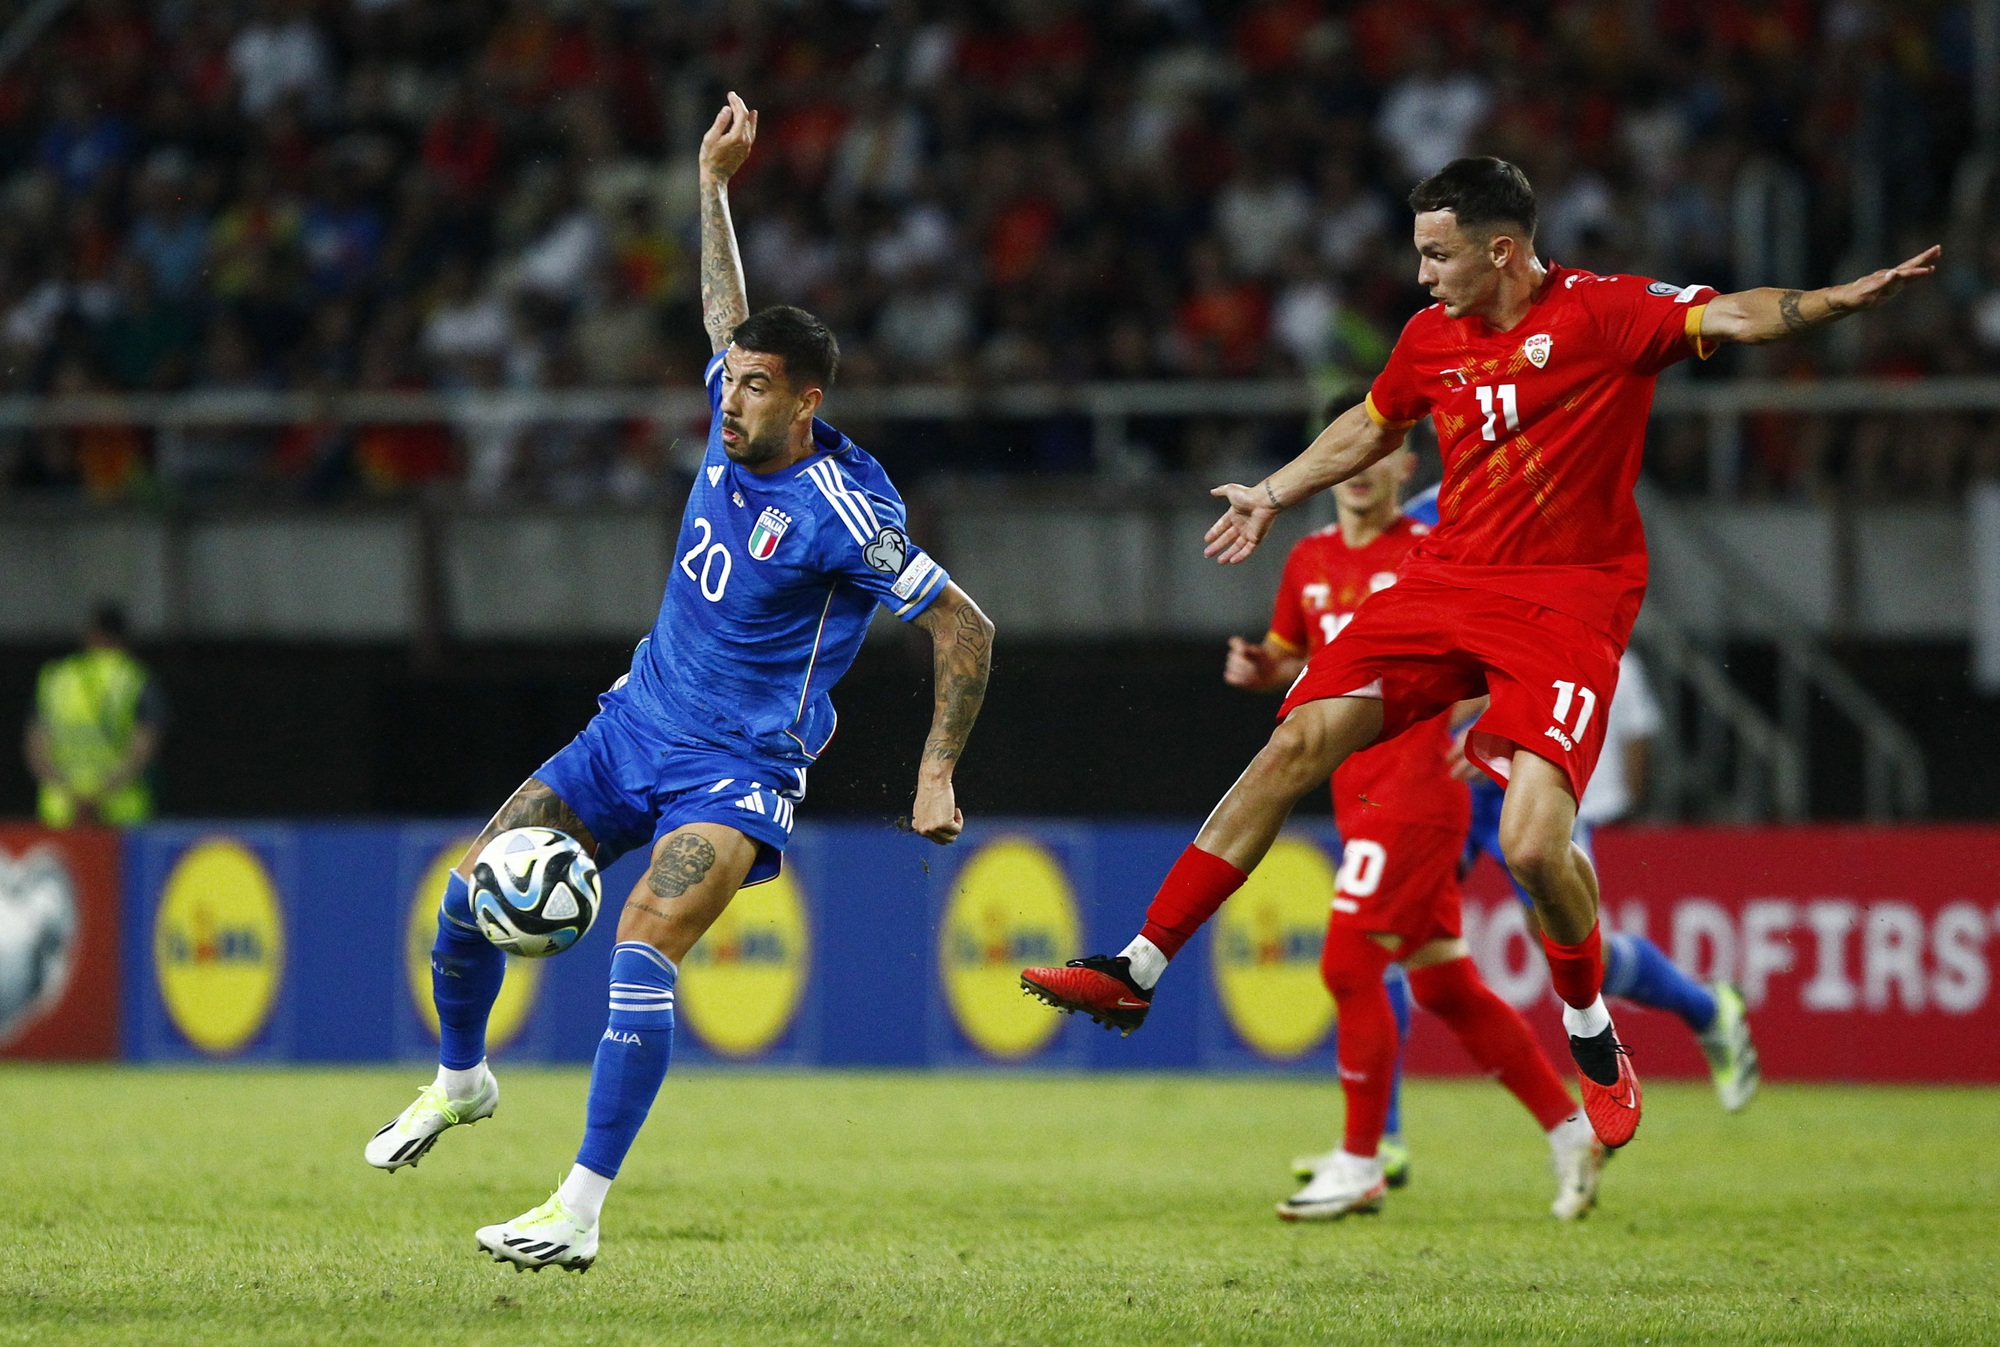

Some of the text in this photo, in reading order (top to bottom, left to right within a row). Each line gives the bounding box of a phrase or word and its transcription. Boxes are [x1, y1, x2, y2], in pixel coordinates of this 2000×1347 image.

[1475, 383, 1520, 441] 11
[760, 513, 784, 535] ITALIA
[680, 517, 732, 602] 20
[1544, 726, 1572, 751] JAKO
[1551, 679, 1597, 744] 11
